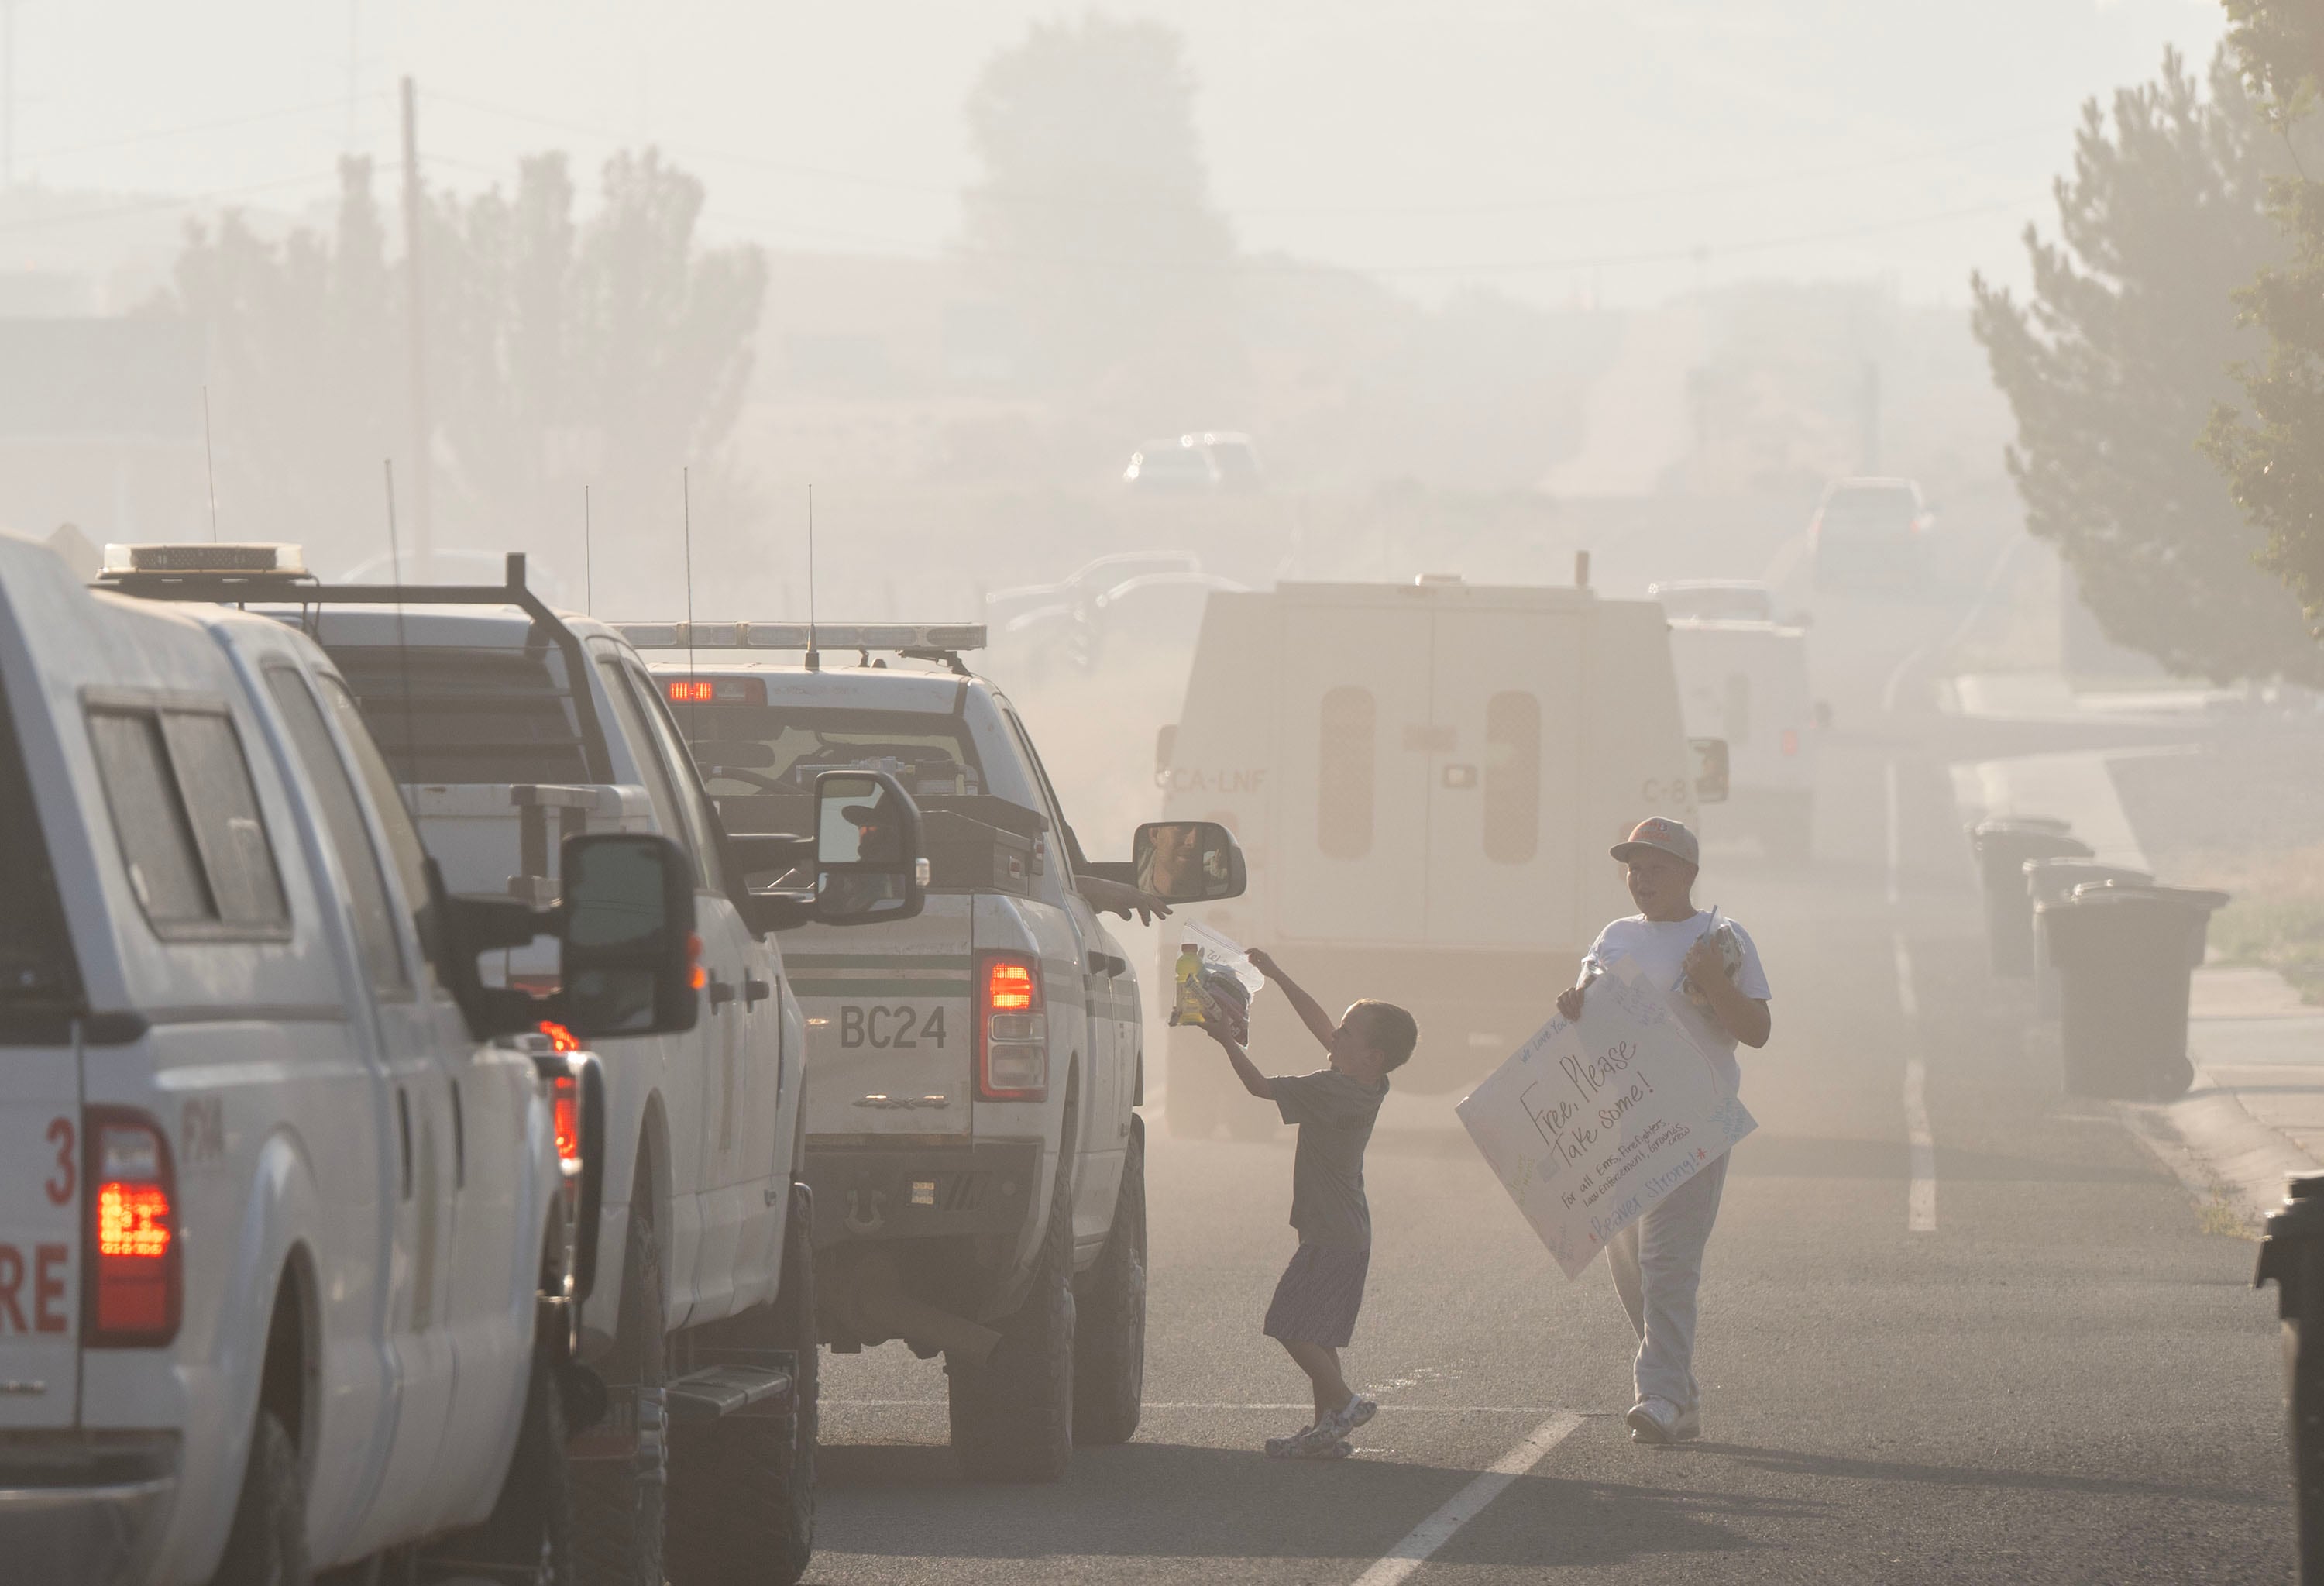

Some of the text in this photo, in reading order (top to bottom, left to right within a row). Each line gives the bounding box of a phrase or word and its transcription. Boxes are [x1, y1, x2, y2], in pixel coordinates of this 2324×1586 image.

[841, 1006, 947, 1048] BC24
[1519, 1041, 1637, 1147] Free, Please
[45, 1116, 75, 1206] 3
[1550, 1127, 1598, 1168] Take
[1580, 1174, 1593, 1192] all
[1590, 1193, 1642, 1244] Beaver
[1644, 1151, 1700, 1199] Strong!
